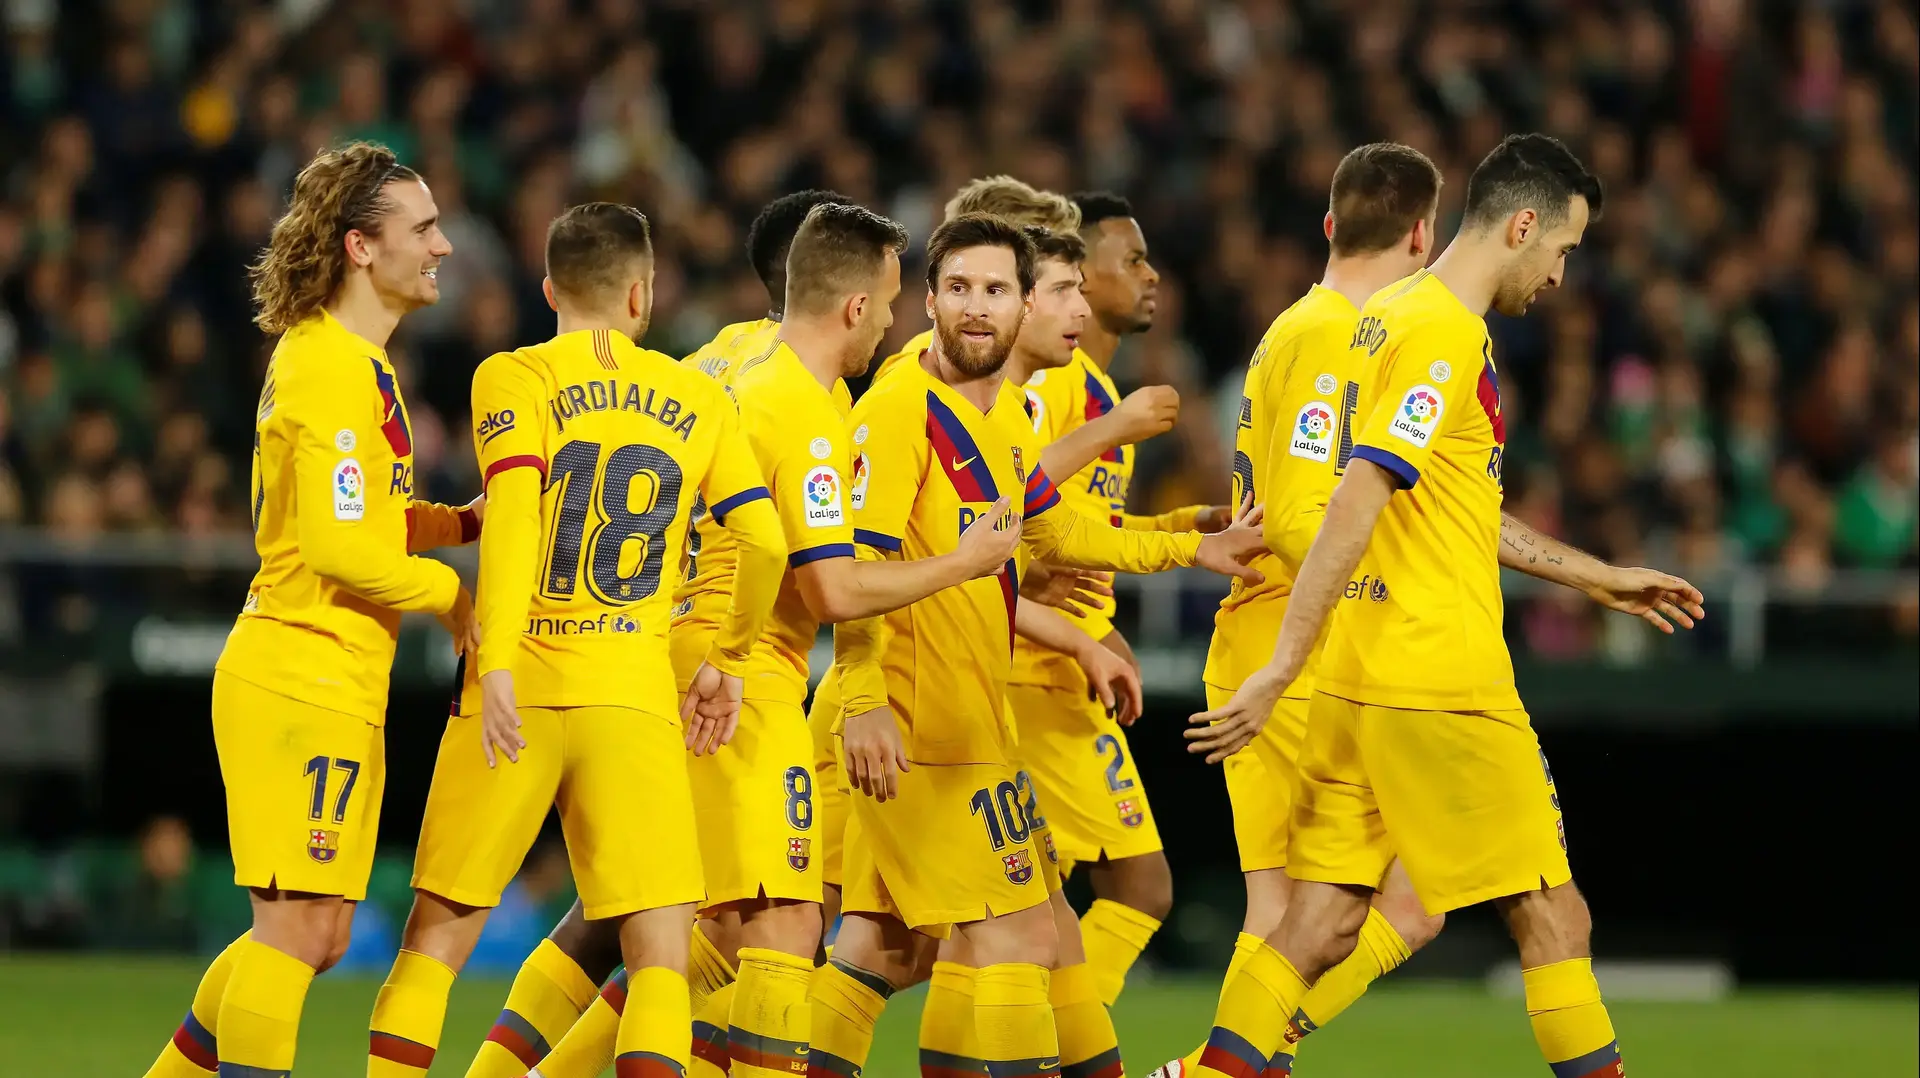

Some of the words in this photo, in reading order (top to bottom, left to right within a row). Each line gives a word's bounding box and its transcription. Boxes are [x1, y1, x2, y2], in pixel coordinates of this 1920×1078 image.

[548, 380, 617, 435] JORDI
[621, 382, 698, 443] ALBA
[1394, 419, 1427, 440] LaLiga
[1294, 440, 1327, 455] LaLiga
[338, 501, 363, 513] LaLiga
[540, 440, 683, 607] 18
[809, 508, 840, 519] LaLiga
[303, 755, 361, 825] 17
[1094, 734, 1135, 796] 2
[783, 766, 813, 831] 8
[969, 781, 1031, 852] 10
